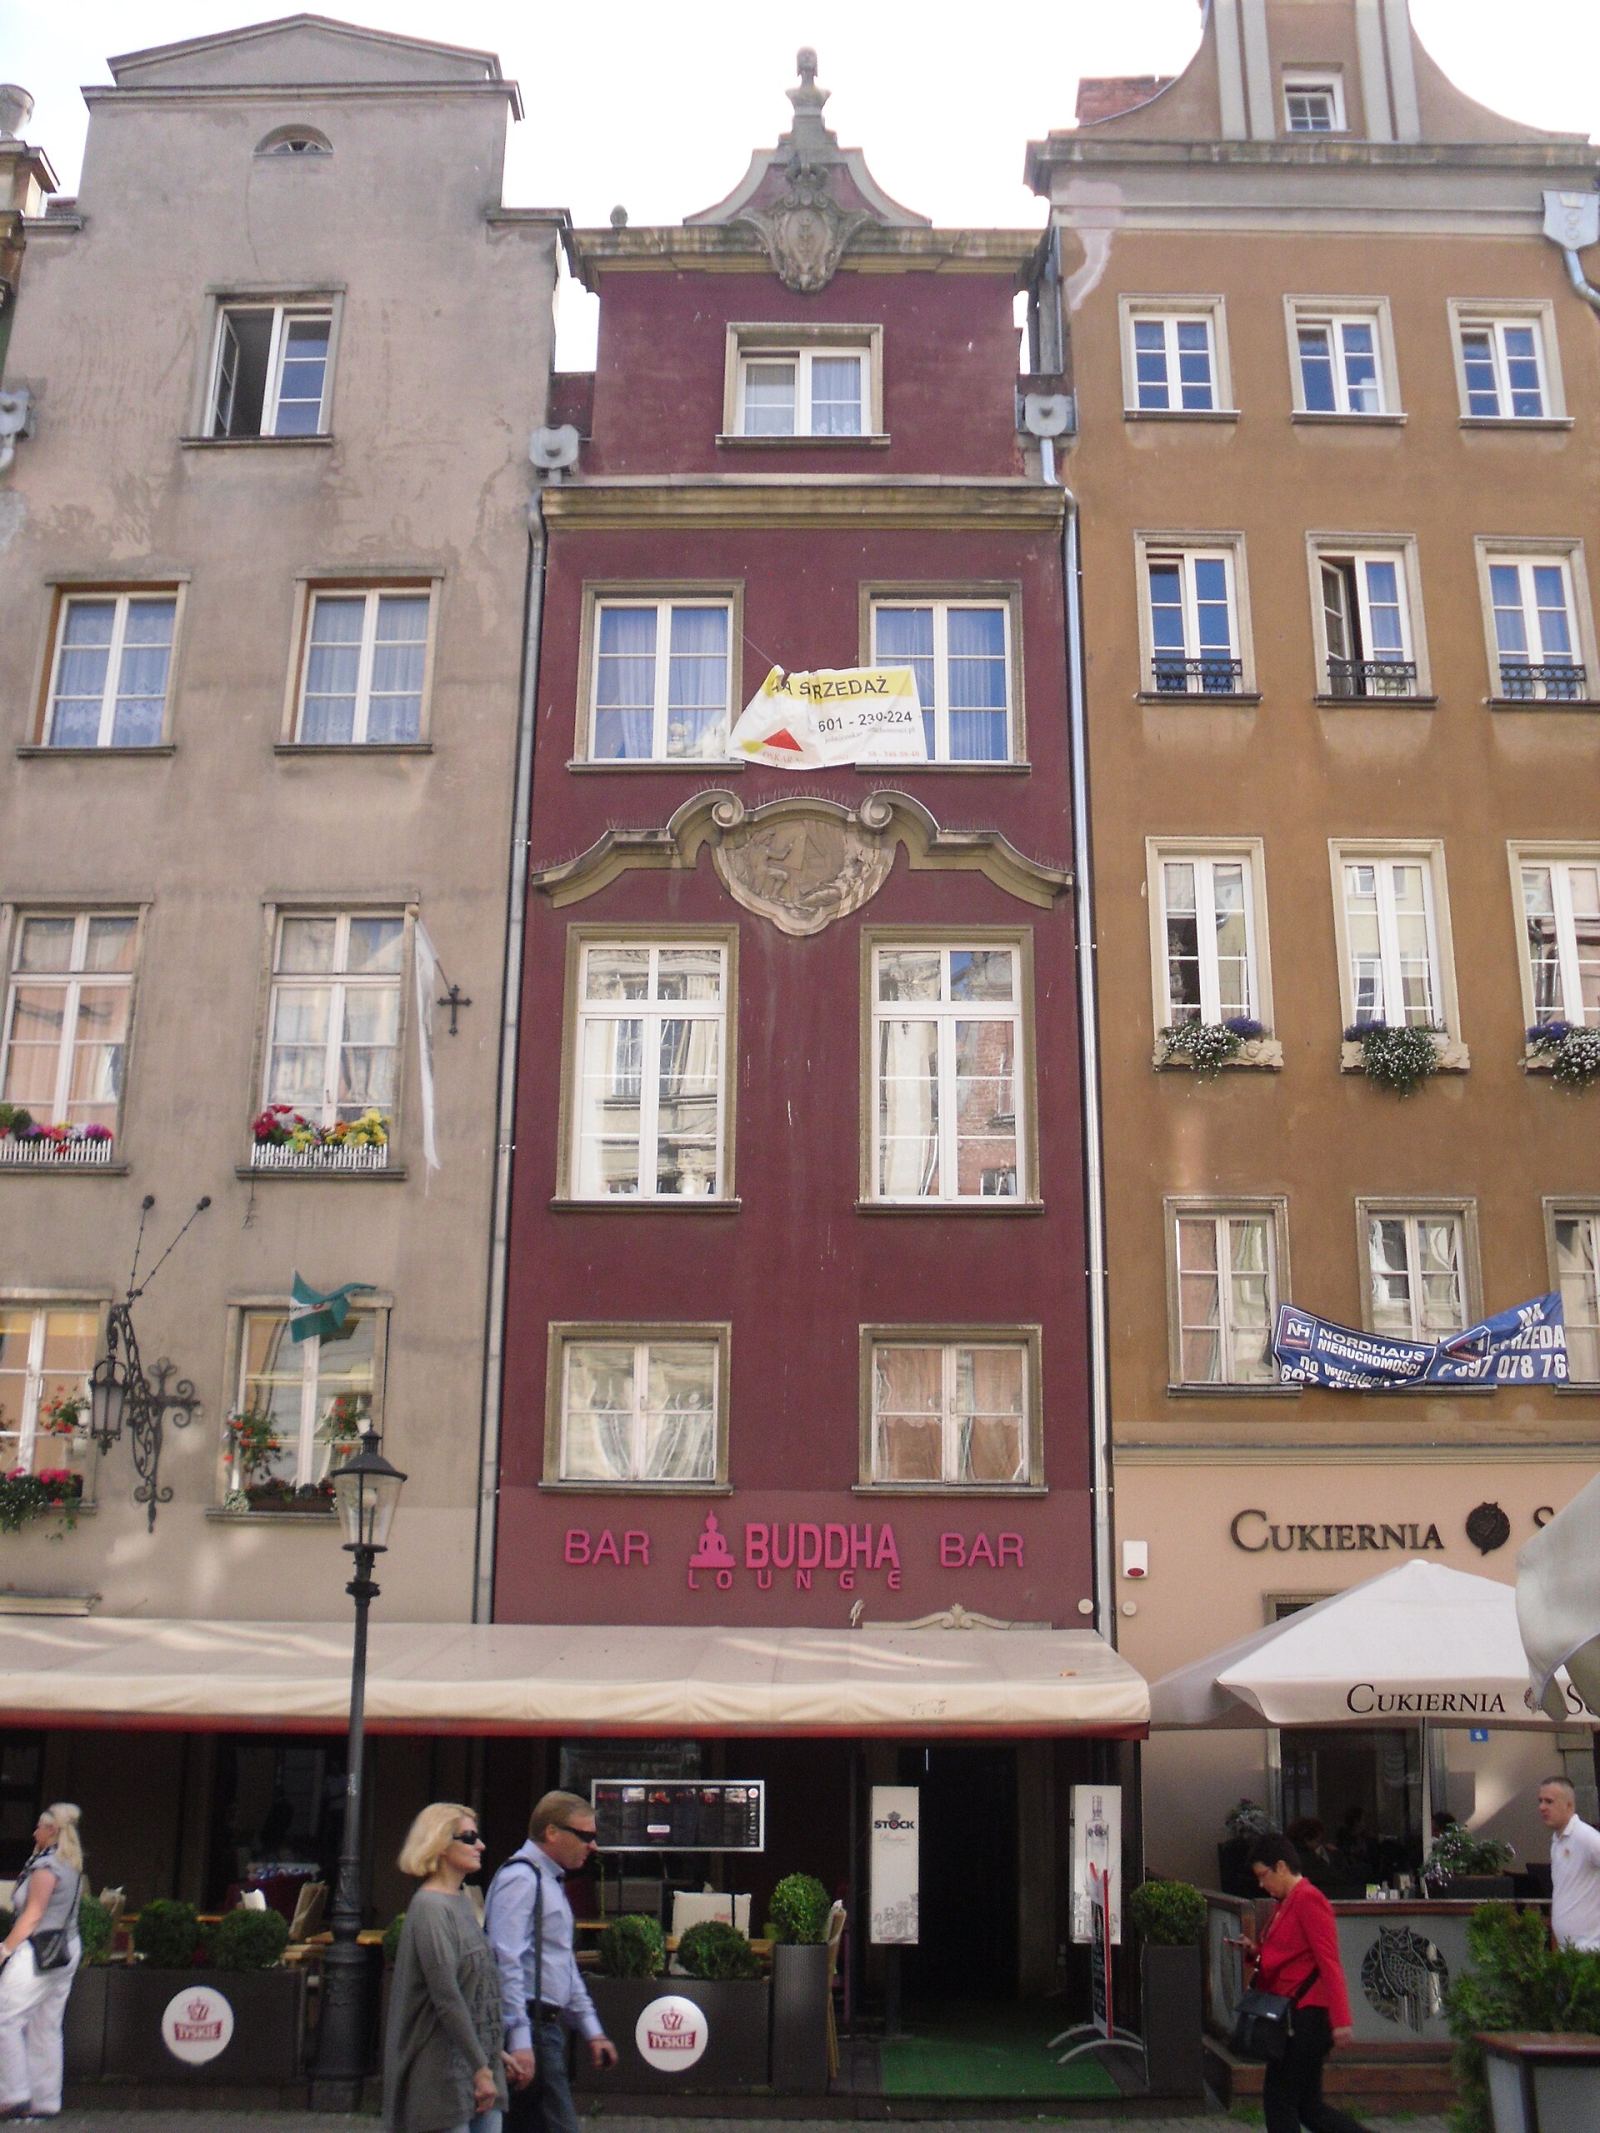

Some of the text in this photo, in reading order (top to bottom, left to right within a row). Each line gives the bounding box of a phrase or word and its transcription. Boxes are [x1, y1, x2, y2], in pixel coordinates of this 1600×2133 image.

[799, 675, 890, 701] SRZEDAŻ
[818, 717, 843, 733] 601
[1517, 1303, 1545, 1330] NA
[1317, 1337, 1422, 1377] NIERUCHOMOŚCI
[1319, 1327, 1426, 1362] NORDHAUS
[1496, 1355, 1535, 1379] 078
[1540, 1353, 1569, 1379] 76
[1229, 1508, 1446, 1552] CUKIERNIA
[564, 1530, 652, 1566] BAR
[745, 1522, 902, 1569] BUDDHA
[939, 1532, 1026, 1568] BAR
[687, 1569, 902, 1590] LOUNGE
[1346, 1683, 1507, 1714] CUKIERNIA
[873, 1819, 915, 1830] STOCK
[649, 2033, 694, 2048] TYSKIE
